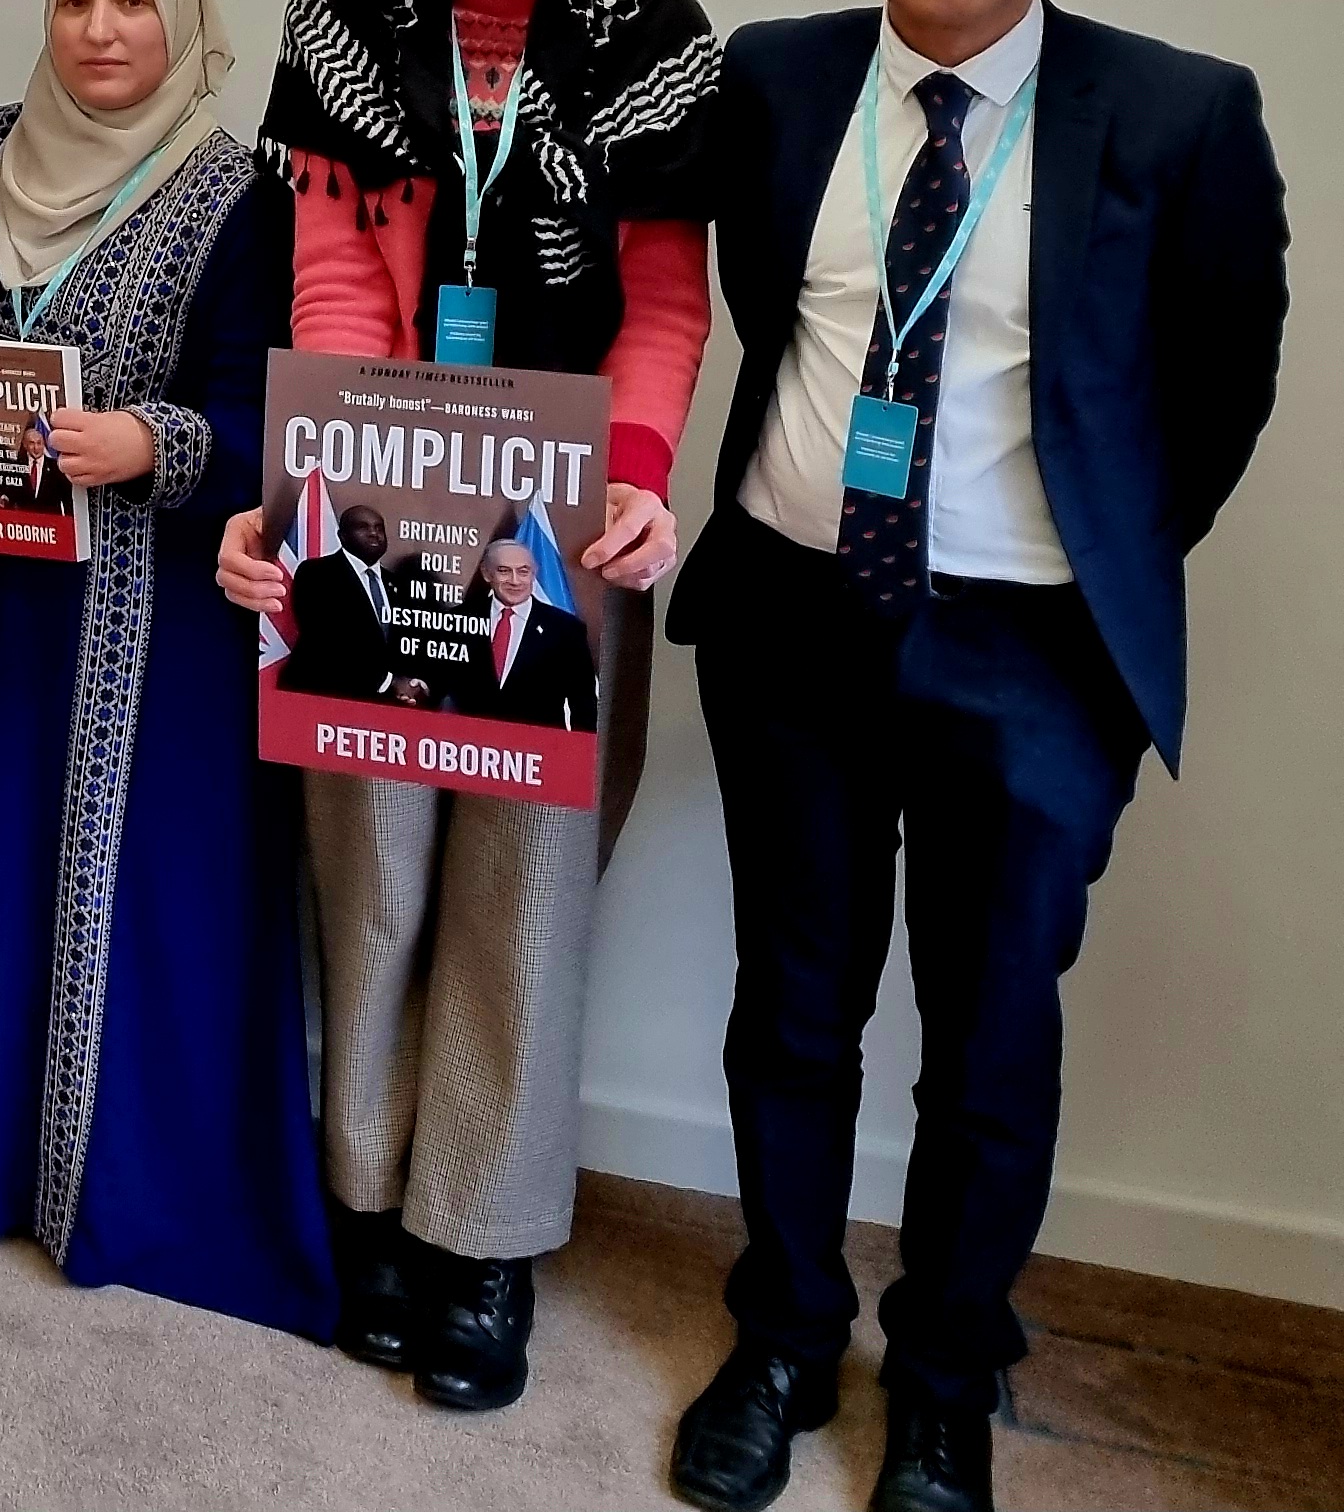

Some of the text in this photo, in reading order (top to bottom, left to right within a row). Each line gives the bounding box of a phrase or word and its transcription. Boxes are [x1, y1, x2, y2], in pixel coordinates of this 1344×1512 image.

[359, 366, 514, 388] A SUNDAY TIMES BESTSELLER
[501, 408, 534, 422] WARSI
[284, 415, 593, 507] COMPLICIT
[7, 523, 57, 545] OBORNE
[399, 520, 479, 548] BRITAIN'S
[421, 552, 462, 575] ROLE
[410, 580, 464, 604] IN THE
[381, 607, 491, 637] DESTRUCTION
[400, 637, 470, 663] OF GAZA
[316, 722, 543, 787] PETER OBORNE
